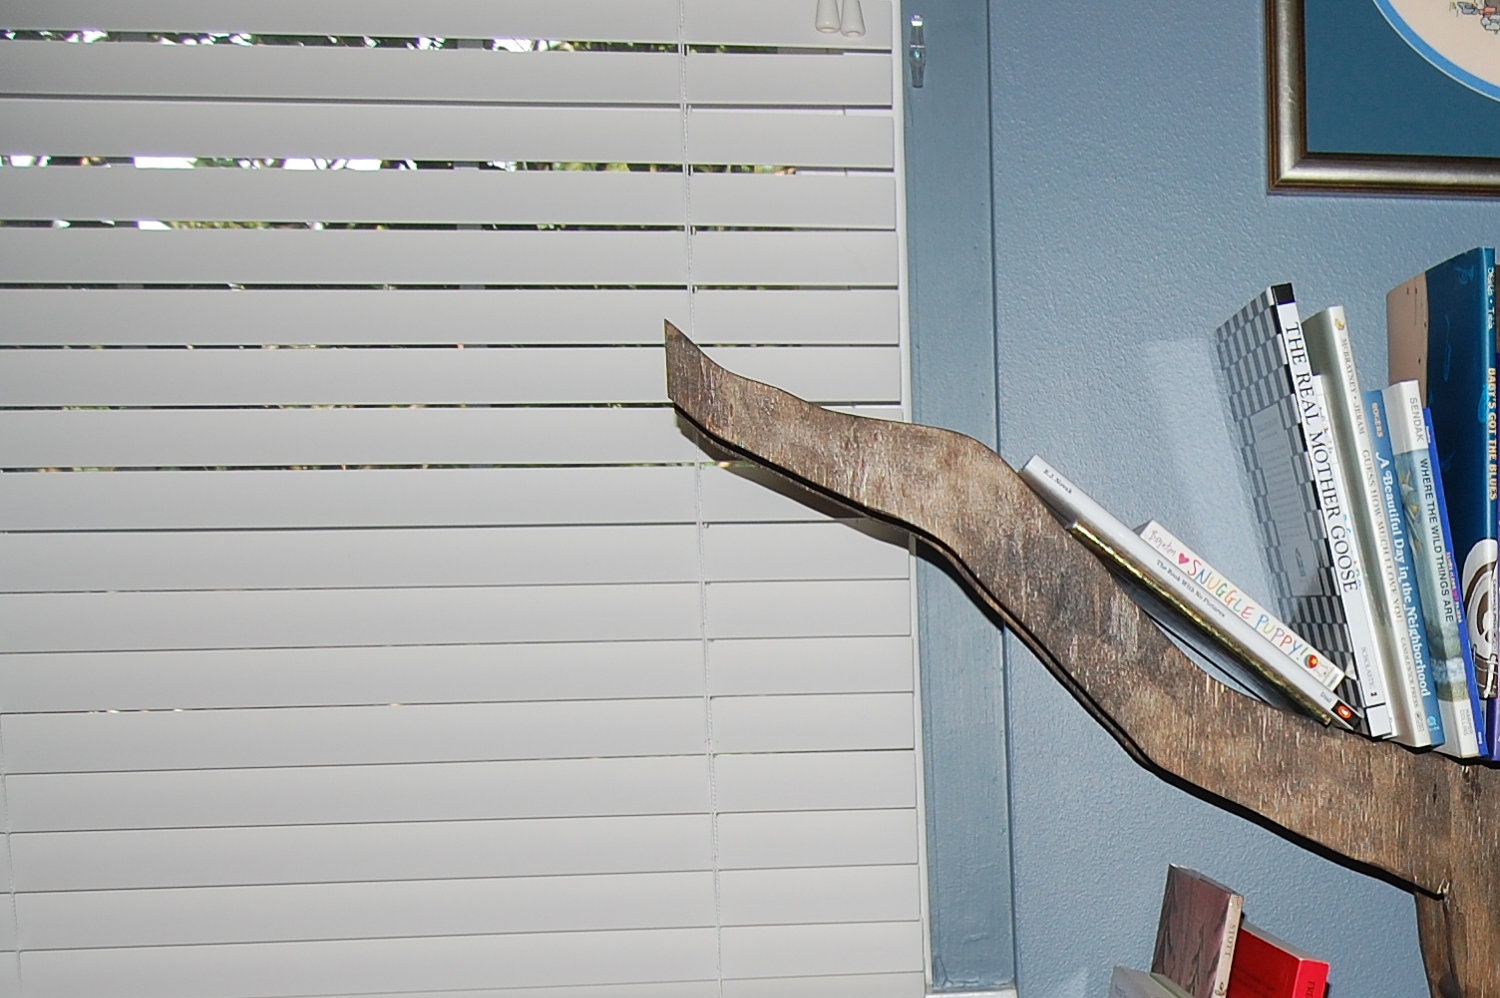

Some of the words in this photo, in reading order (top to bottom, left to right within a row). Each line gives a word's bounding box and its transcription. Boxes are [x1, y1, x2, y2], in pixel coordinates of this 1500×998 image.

[1282, 322, 1307, 366] THE
[1293, 371, 1320, 426] REAL
[1487, 367, 1496, 409] BABY'S
[1351, 401, 1365, 435] JERAM
[1370, 402, 1384, 438] ROGERS
[1408, 396, 1425, 442] SENDAK
[1487, 411, 1496, 435] GOT
[1360, 448, 1376, 486] GUESS
[1374, 450, 1390, 469] A
[1487, 438, 1496, 460] THE
[1306, 429, 1341, 520] MOTHER
[1418, 457, 1435, 501] WHERE
[1487, 463, 1496, 500] BLUES
[1368, 488, 1382, 517] HOW
[1380, 469, 1404, 536] Beautiful
[1426, 501, 1439, 524] THE
[1374, 519, 1389, 556] MUCH
[1390, 537, 1408, 565] Day
[1429, 525, 1444, 554] WILD
[1327, 524, 1357, 594] GOOSE
[1396, 565, 1410, 582] in
[1434, 555, 1451, 596] THINGS
[1155, 559, 1170, 573] The
[1167, 569, 1184, 584] Book
[1179, 579, 1198, 595] With
[1202, 597, 1228, 620] Pictures
[1383, 564, 1397, 593] LOVE
[1400, 581, 1415, 604] the
[1185, 558, 1258, 621] SNUGGLE
[1251, 611, 1310, 663] PUPPY!
[1389, 597, 1402, 622] YOU
[1442, 599, 1455, 622] ARE
[1401, 602, 1432, 697] Neighborhood
[1222, 923, 1237, 958] STOTT
